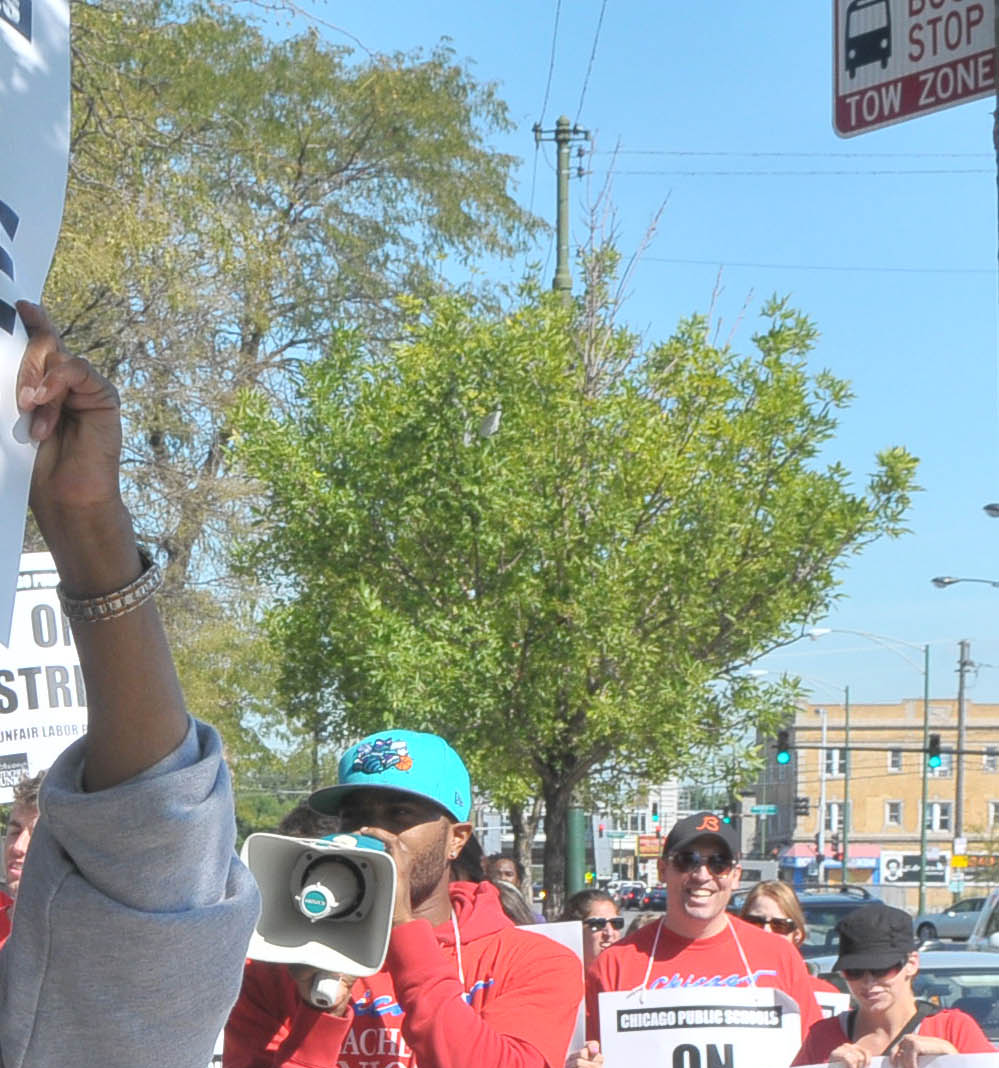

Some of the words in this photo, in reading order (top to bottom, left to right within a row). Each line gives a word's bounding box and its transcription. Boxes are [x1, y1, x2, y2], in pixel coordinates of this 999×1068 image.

[908, 3, 984, 62] STOP
[846, 82, 902, 126] TOW
[918, 53, 994, 106] ZONE
[42, 723, 78, 739] LABOR
[620, 1011, 676, 1029] CHICAGO
[678, 1009, 723, 1026] PUBLIC
[725, 1009, 779, 1026] SCHOOLS
